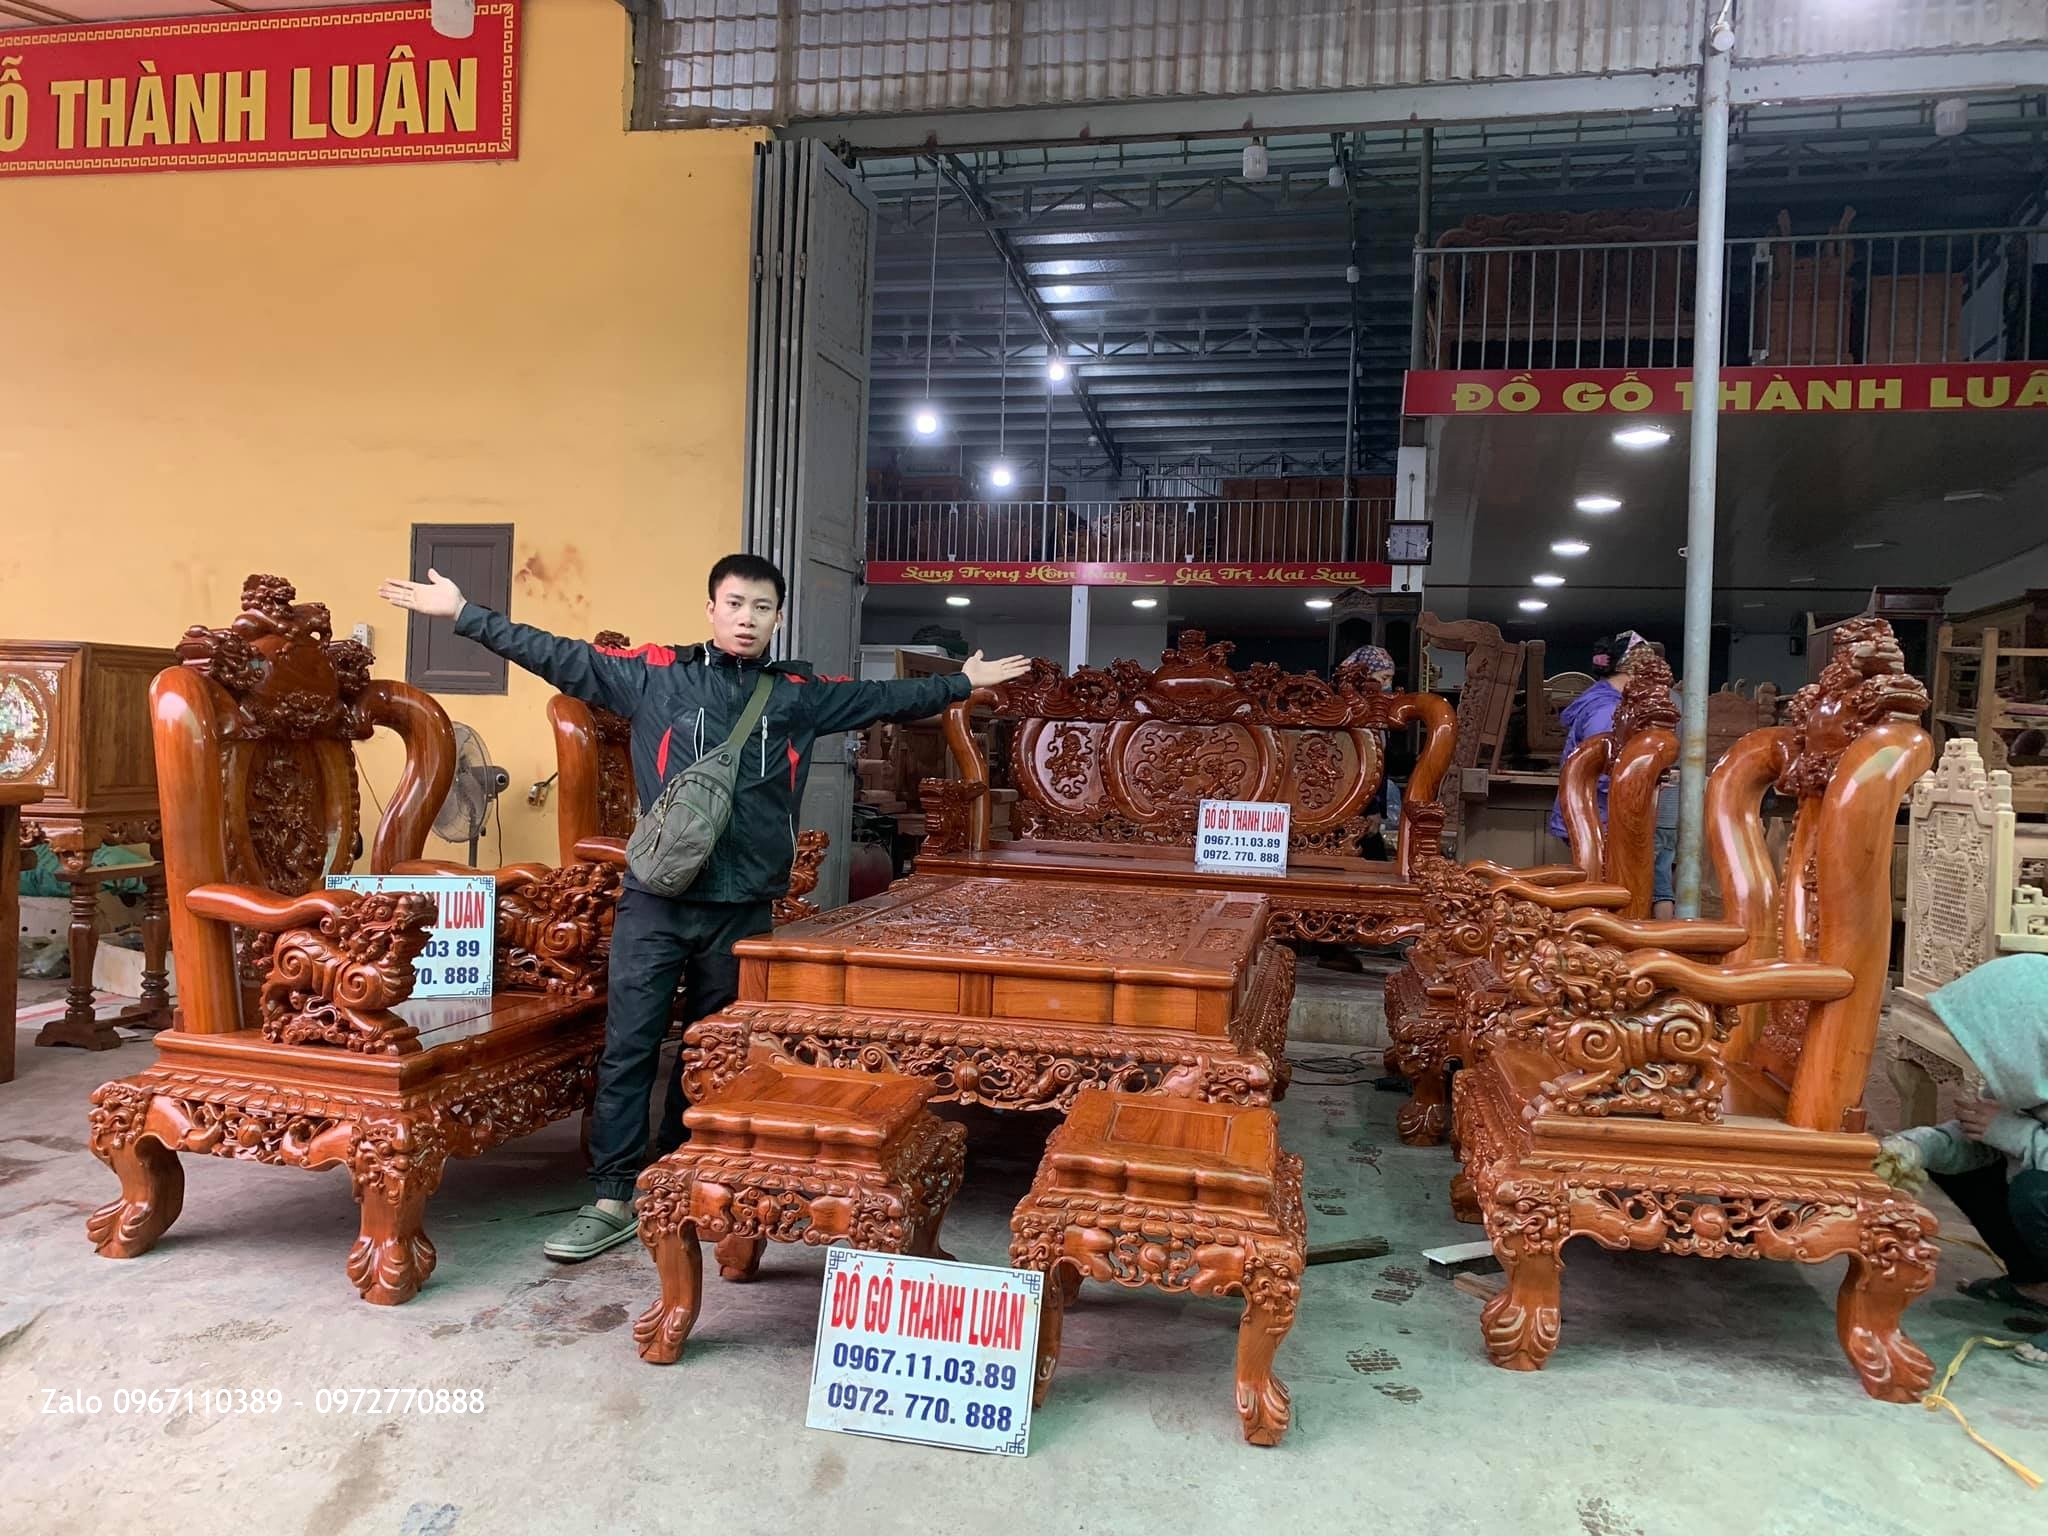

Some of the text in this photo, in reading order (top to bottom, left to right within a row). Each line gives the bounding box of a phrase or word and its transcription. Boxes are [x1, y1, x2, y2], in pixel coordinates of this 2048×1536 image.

[50, 60, 266, 150] THÀNH
[292, 45, 478, 140] LUÂN
[1452, 373, 1541, 412] ĐỒ
[1562, 371, 1654, 412] GỖ
[901, 566, 954, 583] Sang
[959, 566, 1020, 583] Trọng
[1173, 567, 1219, 585] Giá
[1218, 568, 1255, 582] Trị
[1259, 568, 1307, 583] Mai
[1311, 567, 1366, 584] Sau
[1260, 852, 1280, 863] 888
[445, 882, 485, 929] LUÂN
[444, 967, 479, 984] 888
[831, 1261, 1026, 1351] ĐỒ GỖ THÀNH LUÂN
[832, 1342, 1017, 1391] 0967.11.03.89
[827, 1383, 1013, 1432] 0972. 770. 888
